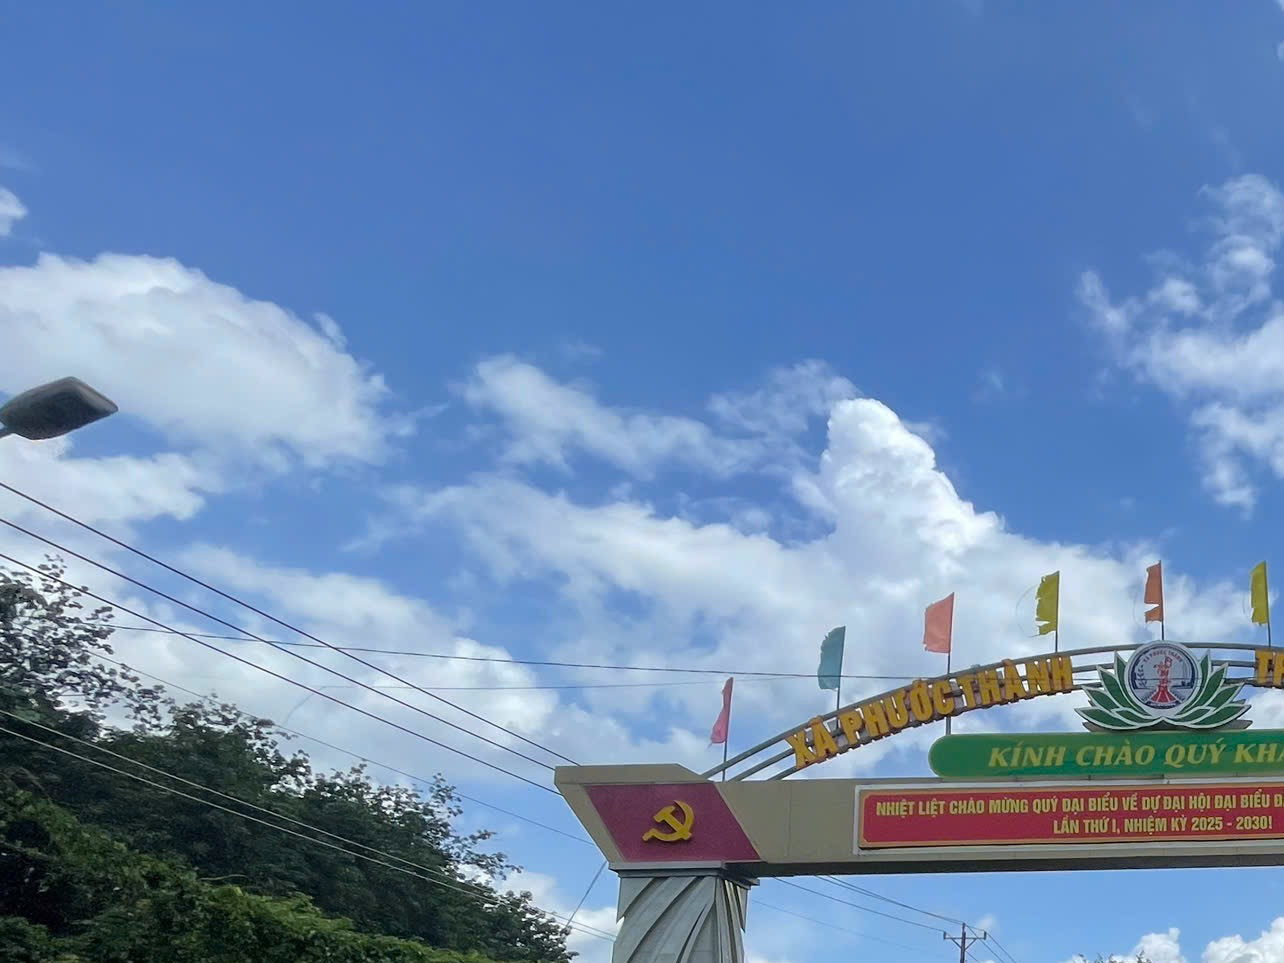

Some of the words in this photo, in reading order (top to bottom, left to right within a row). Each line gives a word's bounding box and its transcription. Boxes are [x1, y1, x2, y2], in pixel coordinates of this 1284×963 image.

[838, 678, 955, 746] PHƯỚC
[956, 656, 1073, 709] THÀNH
[988, 740, 1067, 768] KÍNH
[1075, 739, 1156, 767] CHÀO
[1163, 737, 1227, 769] QUÝ
[876, 798, 915, 818] NHIỆT
[918, 798, 946, 818] LIỆT
[949, 797, 985, 815] CHÀO
[988, 796, 1029, 815] MỪNG
[1032, 795, 1058, 814] QUÝ
[1062, 797, 1084, 815] ĐẠI
[1088, 791, 1118, 812] BIỂU
[1122, 792, 1138, 811] VỀ
[1142, 795, 1161, 813] DỰ
[1163, 796, 1185, 813] ĐẠI
[1189, 792, 1211, 812] HỘI
[1214, 794, 1237, 812] ĐẠI
[1240, 788, 1270, 809] BIỂU
[1053, 814, 1080, 834] LẦN
[1083, 816, 1110, 833] THỨ
[1124, 815, 1167, 835] NHIỆM
[1171, 814, 1187, 832] KỲ
[1191, 816, 1224, 831] 2025
[1236, 815, 1273, 830] 2030!
